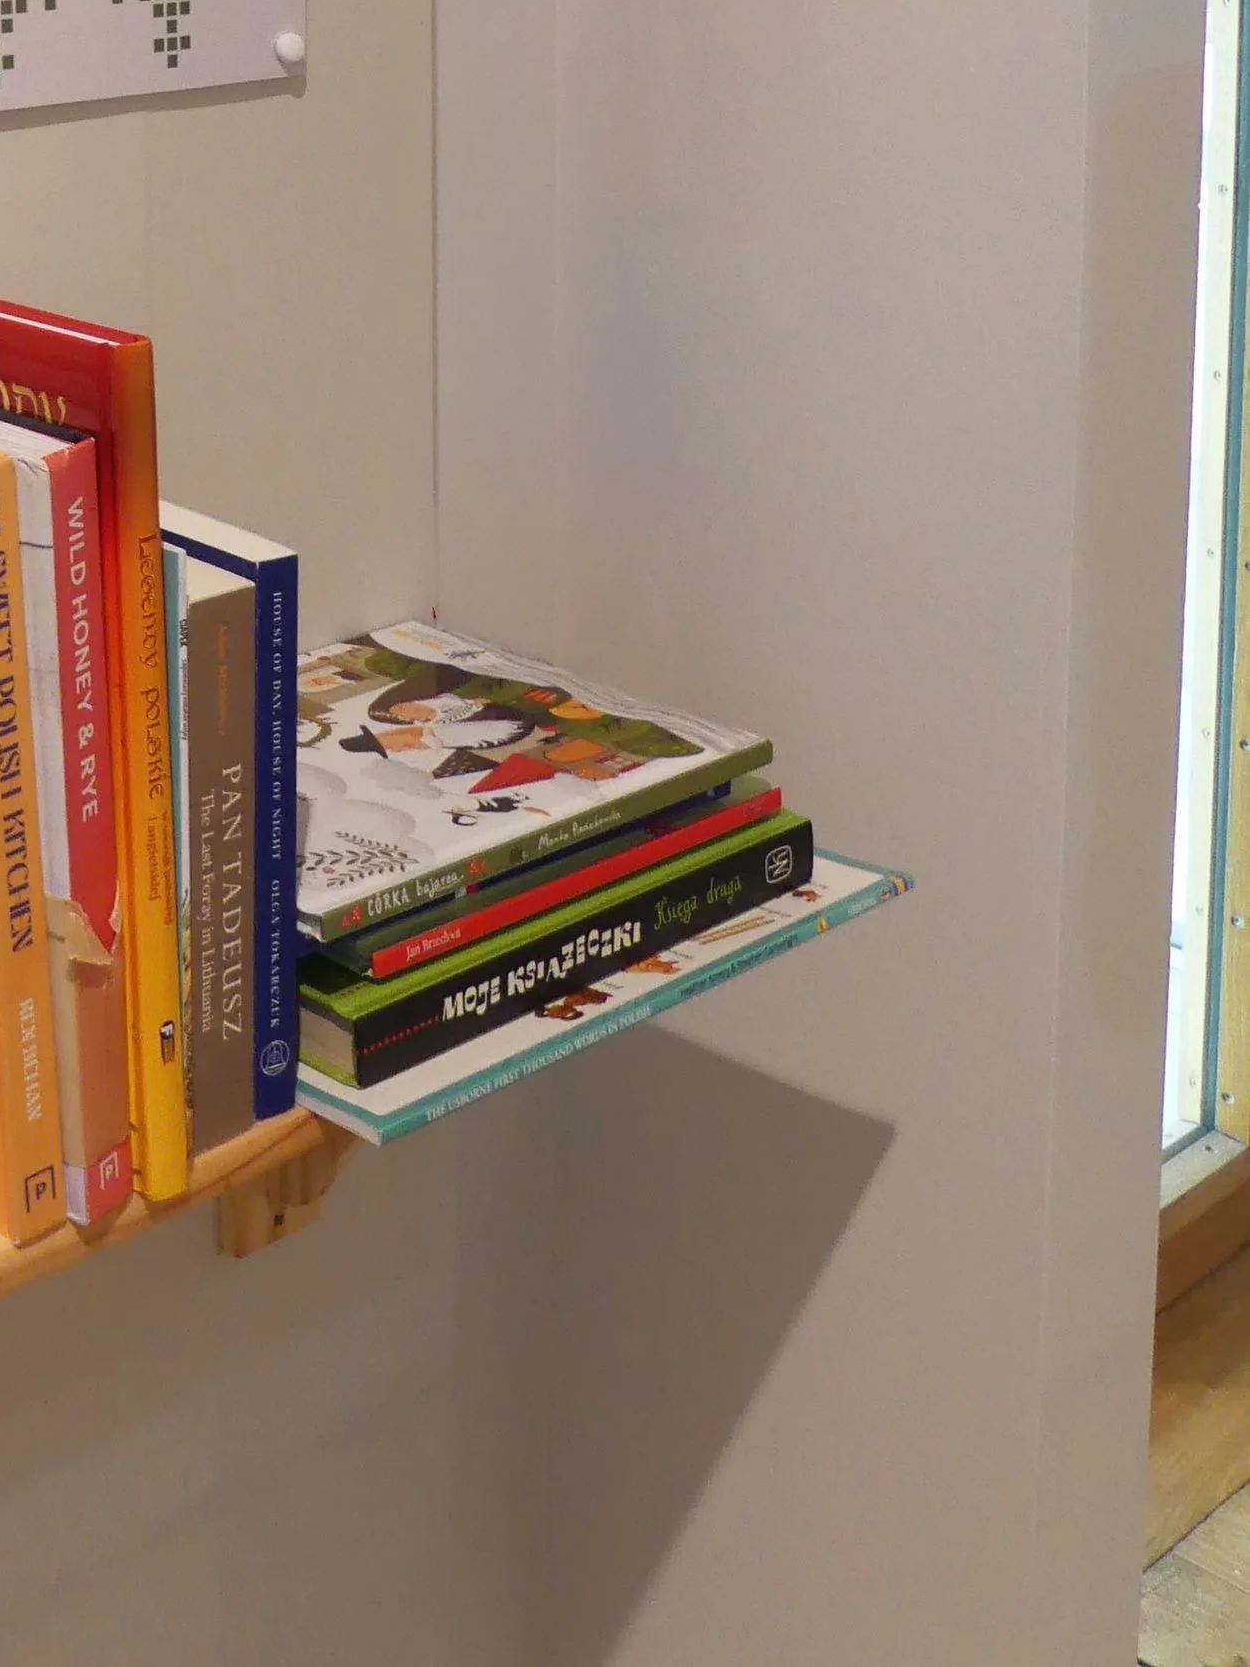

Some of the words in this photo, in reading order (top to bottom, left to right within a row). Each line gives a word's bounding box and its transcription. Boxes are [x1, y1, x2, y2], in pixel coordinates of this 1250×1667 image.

[67, 495, 86, 587] WILD
[272, 591, 283, 647] HOUSE
[72, 594, 93, 712] HONEY
[272, 652, 283, 672] OF
[78, 722, 95, 749] &
[272, 721, 282, 774] HOUSE
[80, 754, 99, 823] RYE
[202, 789, 216, 826] The
[222, 763, 243, 842] PAN
[272, 781, 282, 801] OF
[202, 832, 216, 869] Last
[272, 808, 282, 860] NIGHT
[2, 808, 34, 953] KITCHEN
[197, 872, 216, 922] Foray
[270, 880, 280, 924] OLGA
[367, 886, 410, 917] CÓRKA
[653, 896, 698, 930] Księga
[706, 875, 742, 906] druga
[202, 926, 215, 946] in
[222, 852, 243, 1040] TADEUSZ
[406, 942, 421, 962] Jan
[202, 950, 216, 1033] Lithuania
[270, 929, 280, 1028] TOKARCZUK
[443, 976, 500, 1022] MOJE
[425, 1103, 446, 1123] THE
[447, 1083, 493, 1111] USBORNE
[494, 1070, 521, 1091] FIRST
[521, 1043, 573, 1076] THOUSAND
[606, 1023, 618, 1037] IN
[619, 1005, 651, 1031] POLISH
